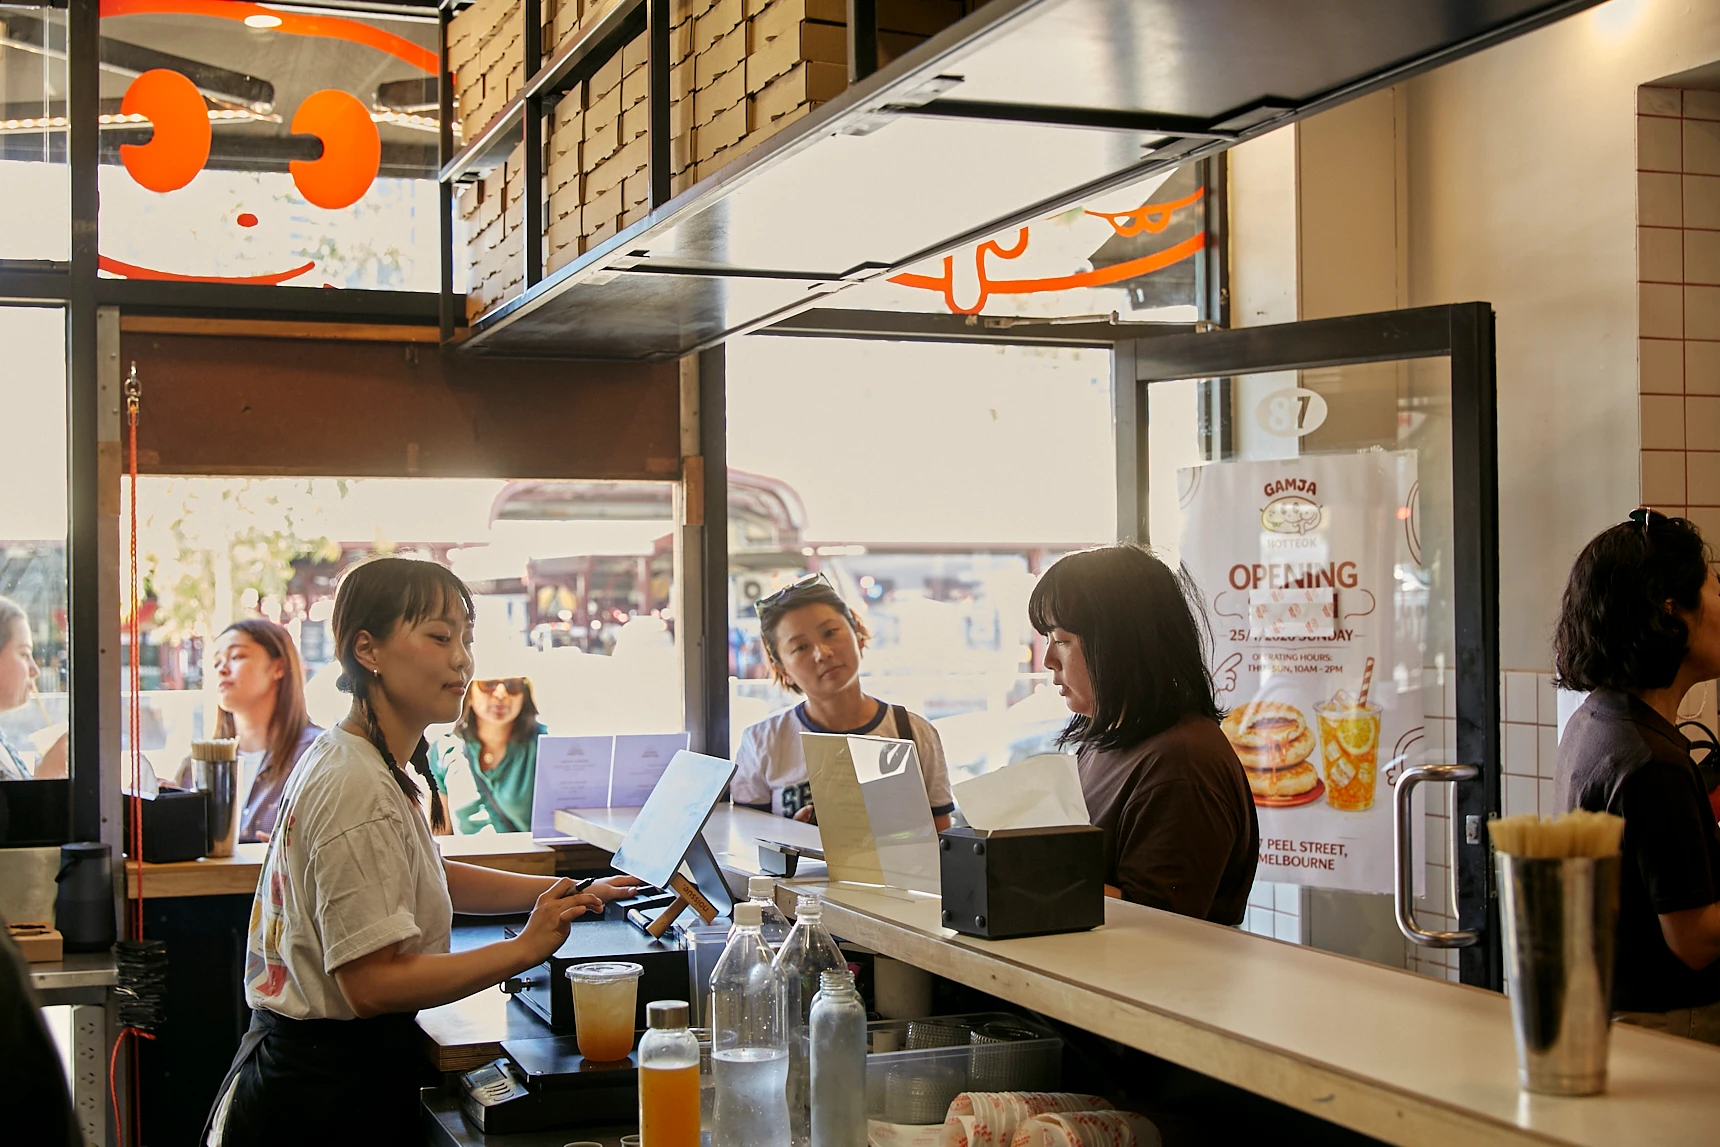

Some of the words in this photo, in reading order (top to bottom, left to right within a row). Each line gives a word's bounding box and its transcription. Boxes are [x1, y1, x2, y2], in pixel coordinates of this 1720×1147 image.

[1269, 395, 1311, 431] 87
[1263, 478, 1317, 497] GAMJA
[1267, 538, 1317, 549] HOTTEOK
[1228, 561, 1358, 590] OPENING
[1299, 653, 1332, 661] HOURS:
[1294, 664, 1317, 672] 10AM
[1324, 664, 1343, 673] 2PM
[1267, 838, 1297, 852] PEEL
[1299, 840, 1348, 858] STREET,
[1258, 853, 1335, 870] MELBOURNE
